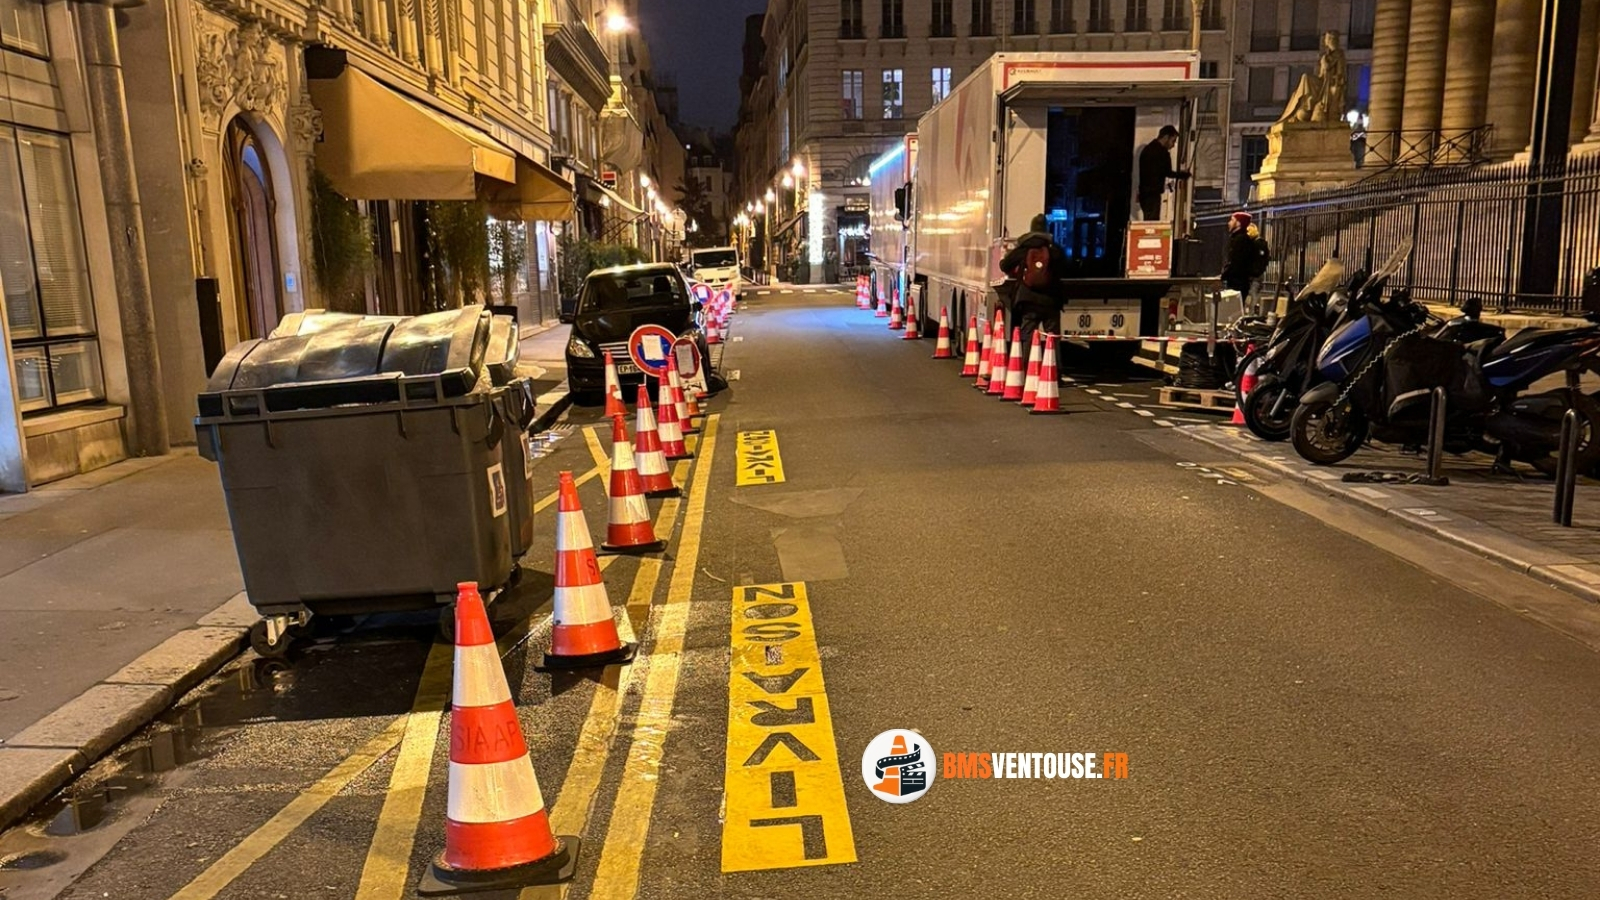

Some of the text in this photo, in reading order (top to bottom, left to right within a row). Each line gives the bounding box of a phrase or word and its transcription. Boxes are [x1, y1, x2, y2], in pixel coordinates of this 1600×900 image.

[1078, 314, 1091, 328] 80
[1111, 314, 1124, 328] 90
[743, 584, 828, 860] LIVRAISON
